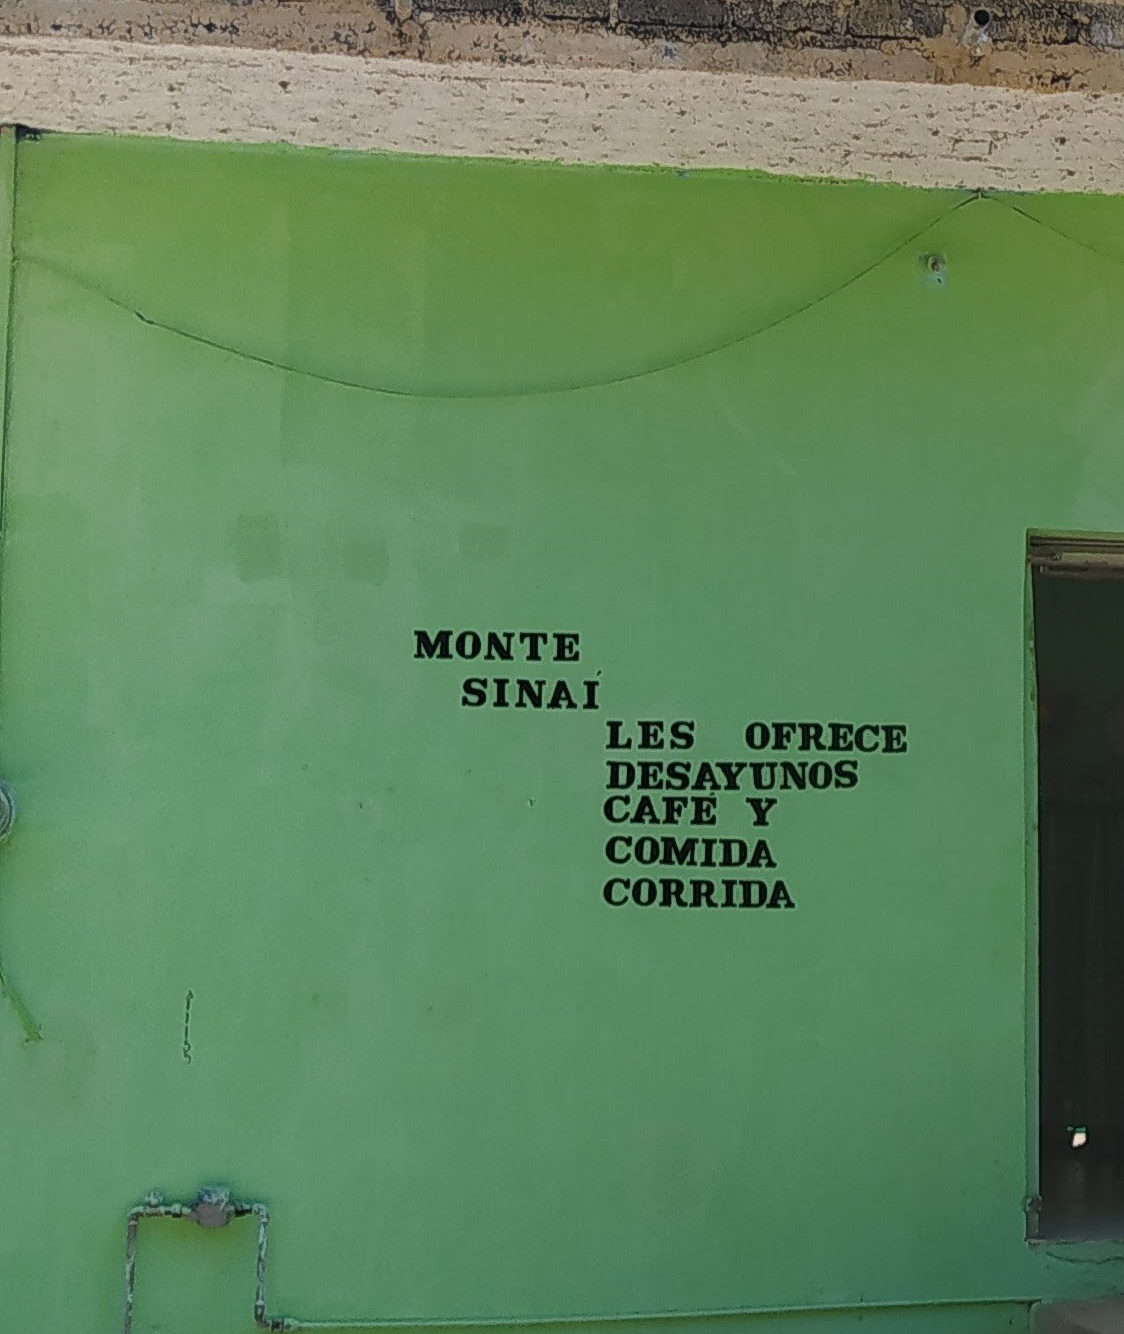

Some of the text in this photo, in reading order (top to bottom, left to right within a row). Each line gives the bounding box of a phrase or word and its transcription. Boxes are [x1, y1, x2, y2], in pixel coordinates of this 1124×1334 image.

[414, 630, 580, 662] MONTE
[606, 720, 908, 754] LES OFRECE
[606, 759, 859, 791] DESAYUNOS
[745, 797, 778, 827] Y
[605, 835, 777, 869] COMIDA
[603, 877, 796, 909] CORRIDA
